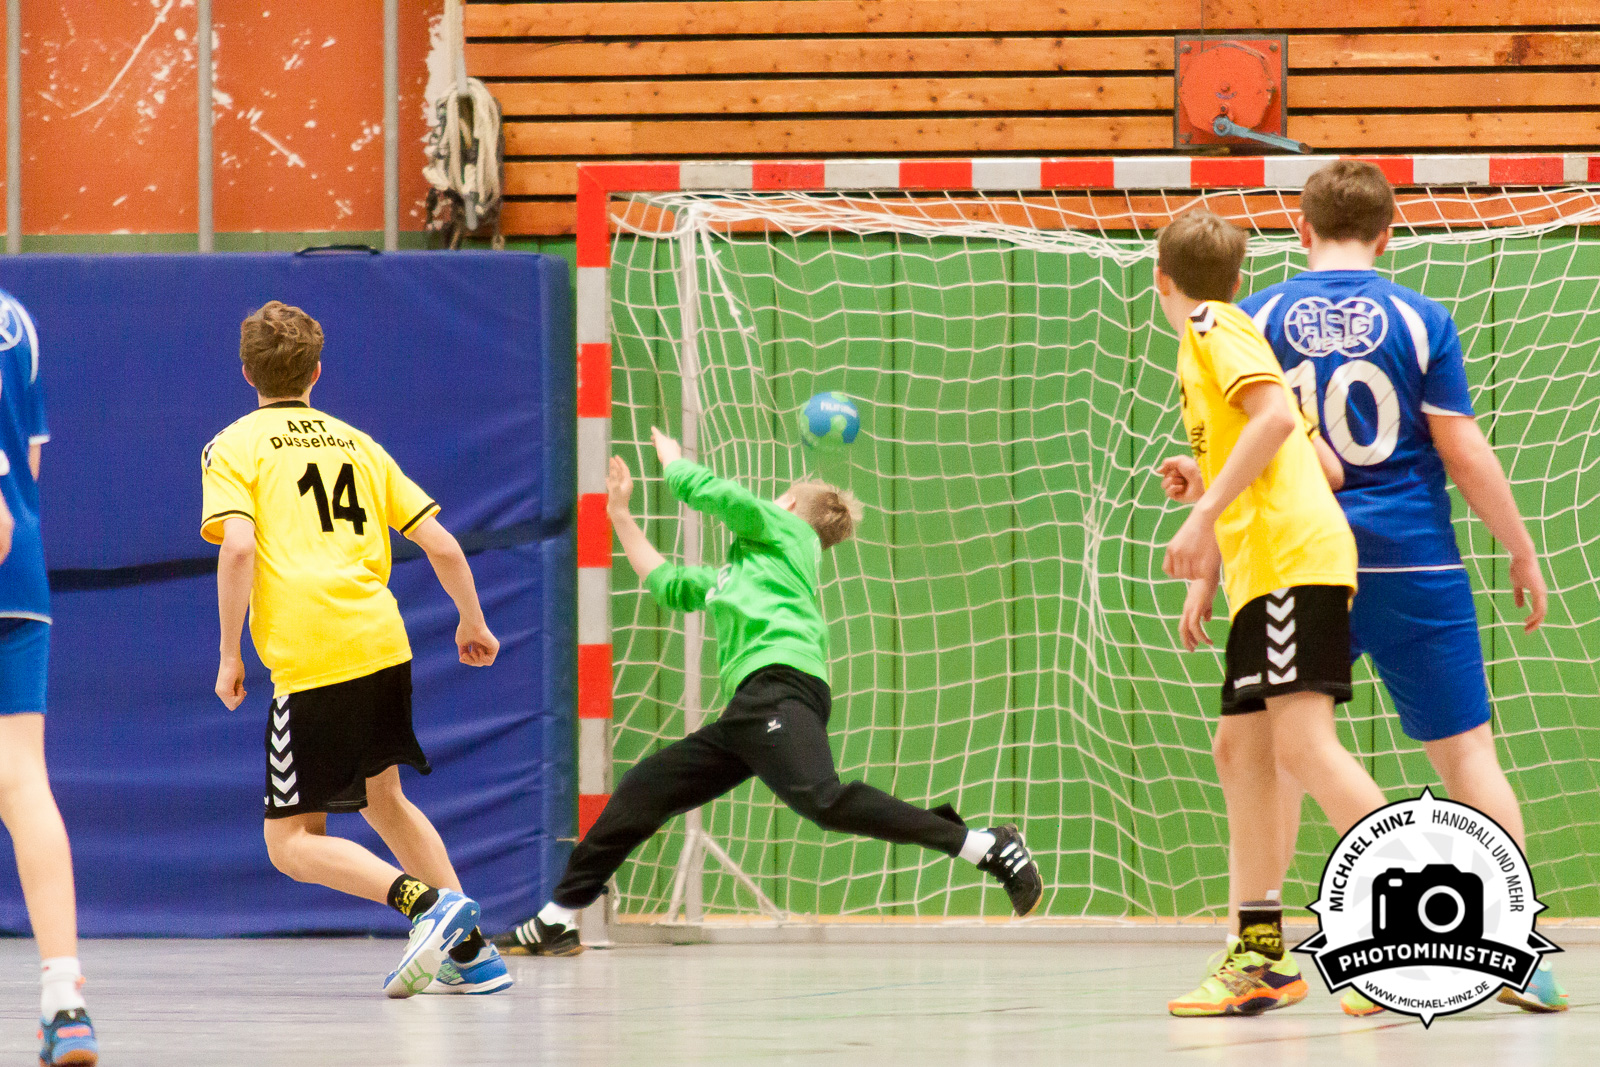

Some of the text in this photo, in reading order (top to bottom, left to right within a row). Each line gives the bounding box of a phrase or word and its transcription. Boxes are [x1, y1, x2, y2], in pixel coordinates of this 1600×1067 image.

[287, 420, 327, 434] ART
[1285, 360, 1400, 466] 10
[270, 434, 356, 451] Düsseldorf
[297, 463, 367, 536] 14
